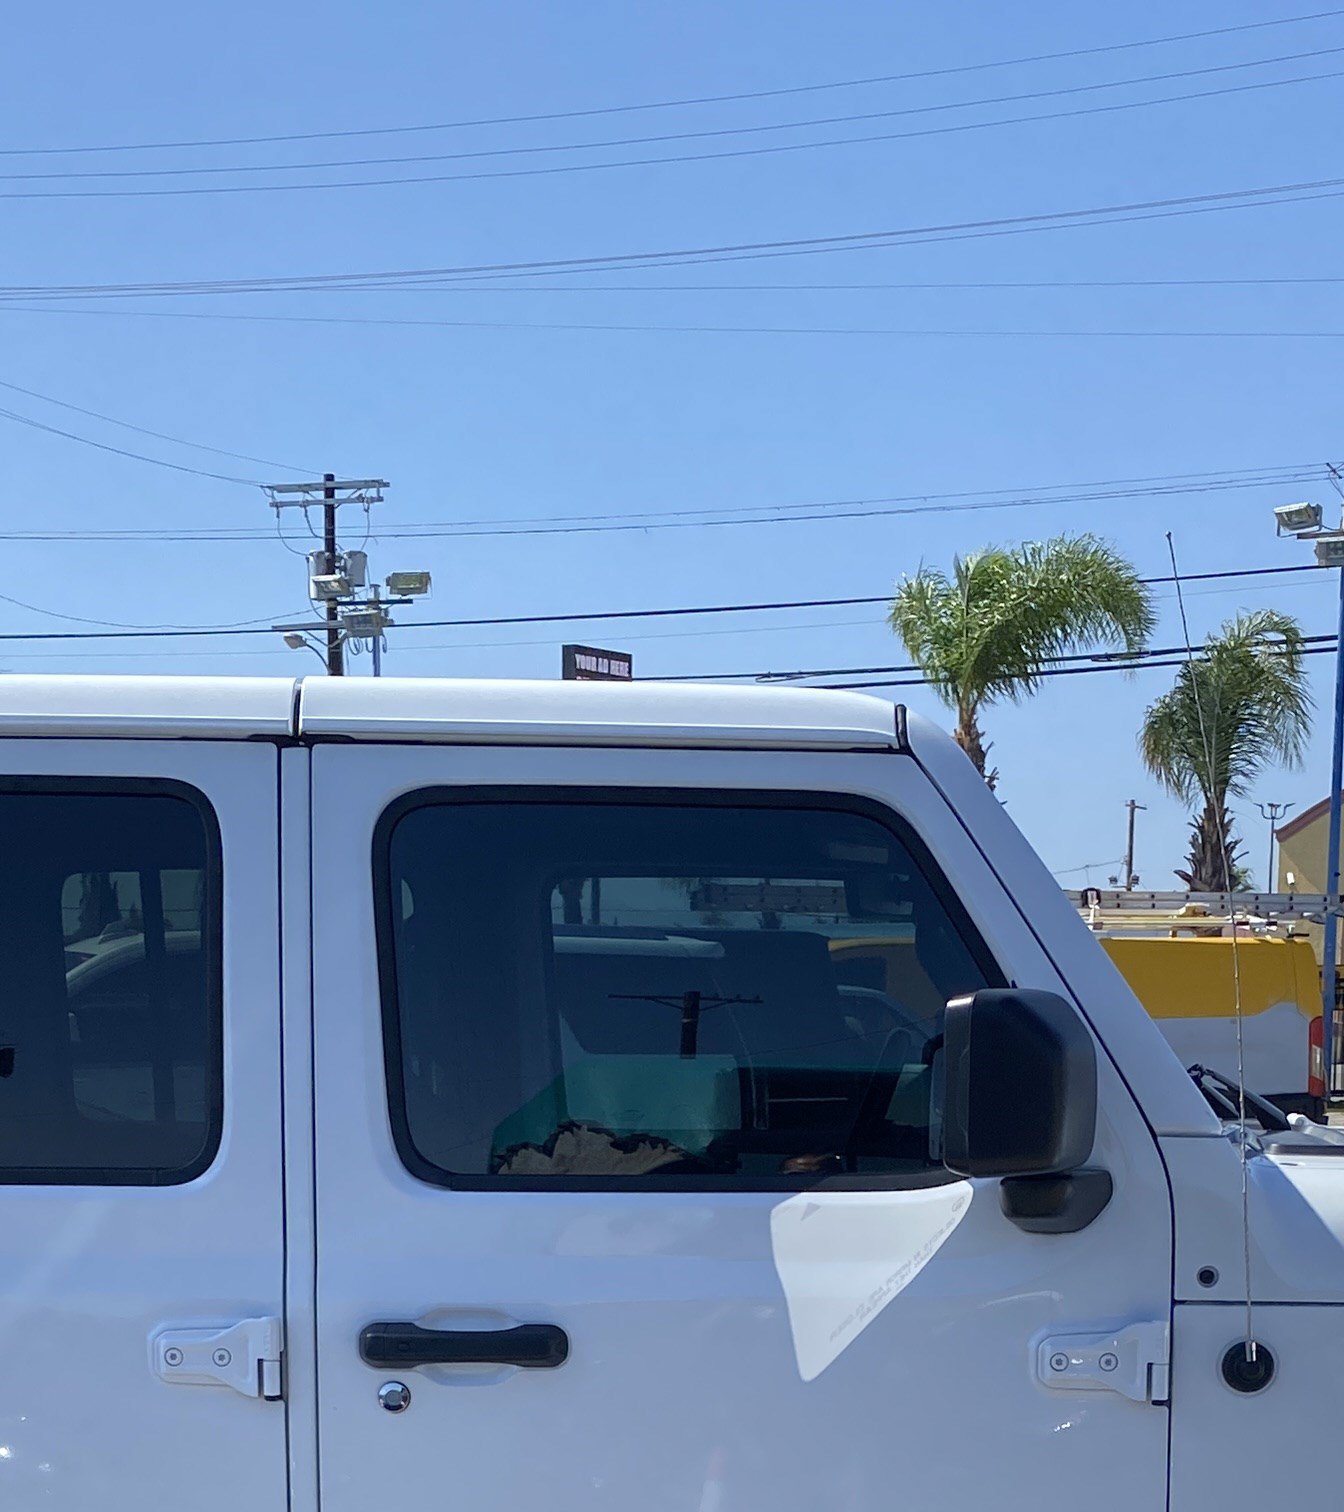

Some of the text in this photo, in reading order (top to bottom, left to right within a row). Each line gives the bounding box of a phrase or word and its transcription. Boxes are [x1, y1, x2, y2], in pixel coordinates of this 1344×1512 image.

[574, 653, 630, 677] YOUR AD HERE
